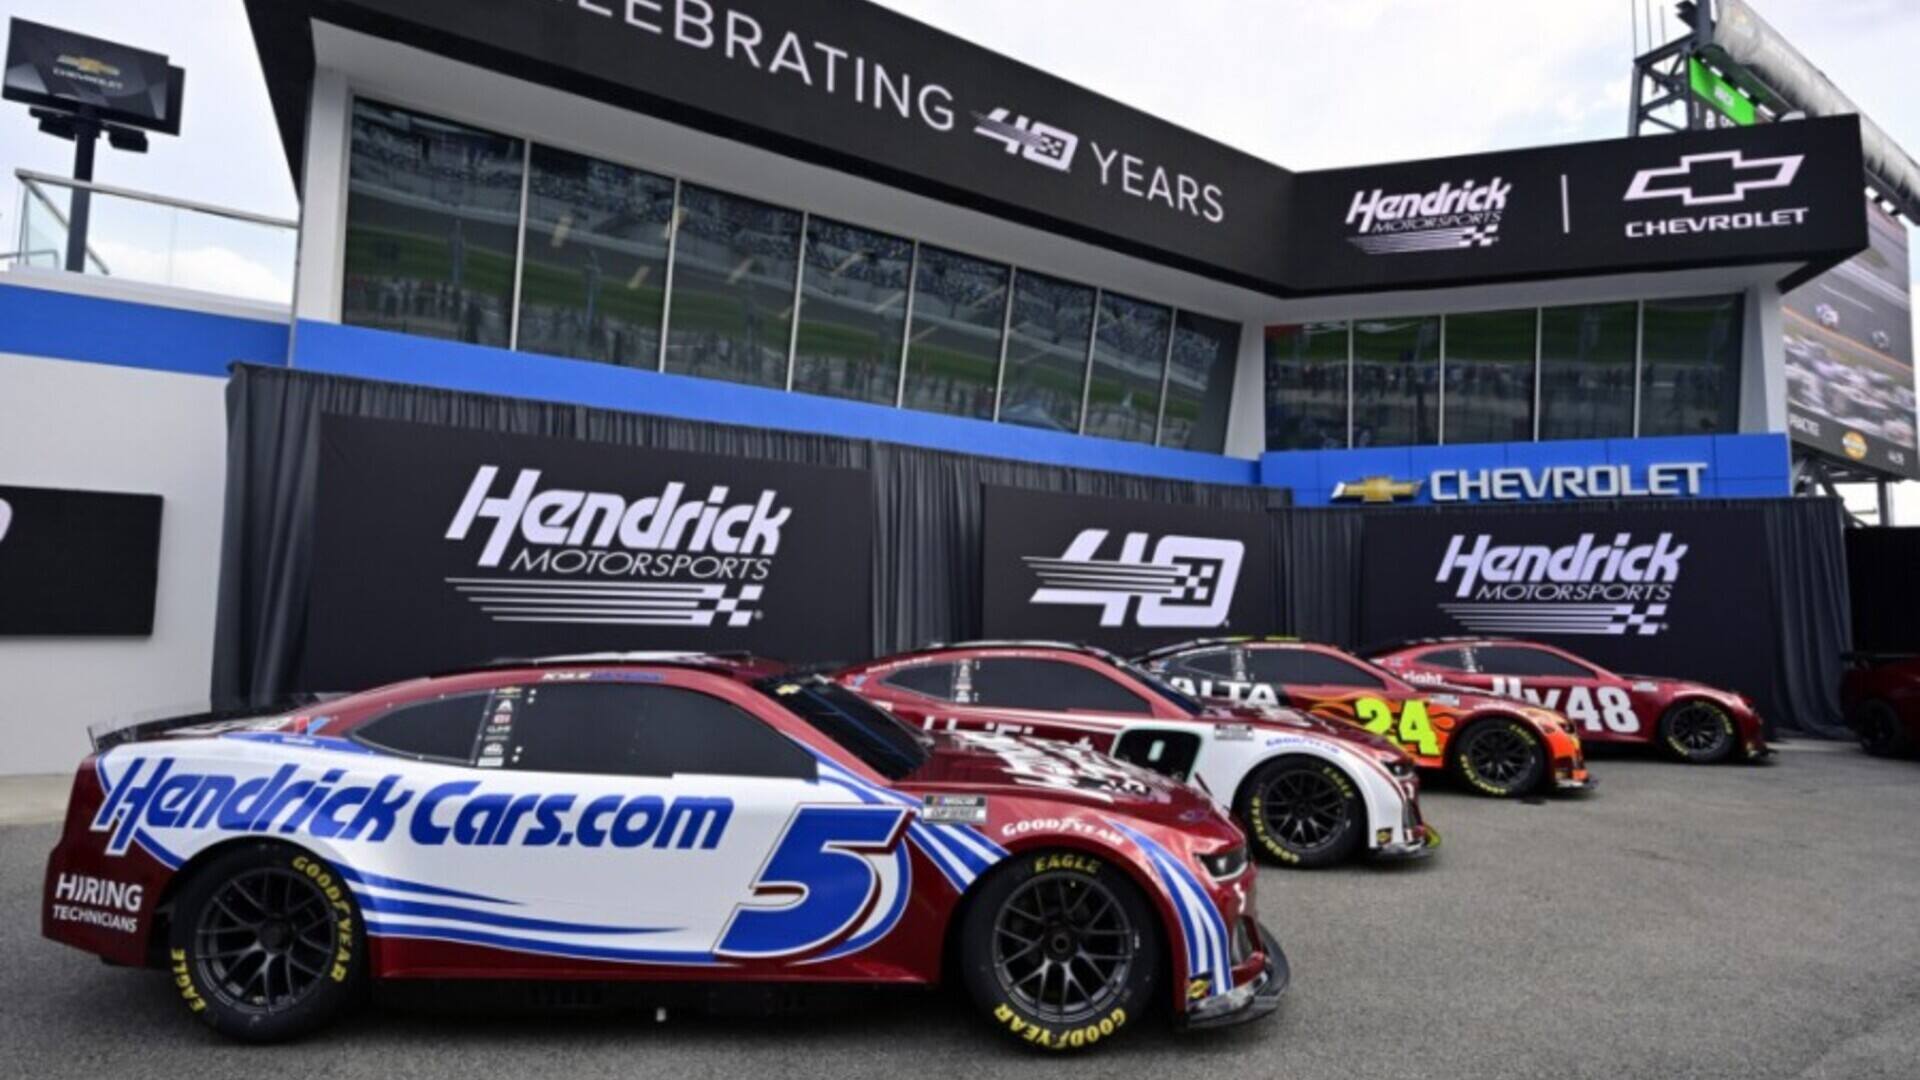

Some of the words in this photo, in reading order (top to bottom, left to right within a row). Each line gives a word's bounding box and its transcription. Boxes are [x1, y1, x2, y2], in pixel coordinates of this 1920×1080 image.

[974, 107, 1079, 172] 40
[1090, 140, 1224, 224] YEARS
[1345, 176, 1513, 234] Hendrick
[1372, 211, 1502, 233] MOTORSPORTS
[1624, 207, 1809, 238] CHEVROLET
[1430, 463, 1708, 501] CHEVROLET
[445, 465, 792, 567] Hendrick
[509, 547, 772, 581] MOTORSPORTS
[1029, 528, 1245, 627] 40
[1435, 532, 1689, 598] Hendrick
[1475, 582, 1673, 601] MOTORSPORTS
[1355, 697, 1440, 756] 24
[1566, 685, 1641, 734] 48
[1002, 817, 1124, 845] GOODYEAR
[712, 803, 908, 958] 5
[1035, 854, 1099, 873] EAGLE
[55, 872, 143, 912] HIRING
[53, 904, 138, 933] TECHNICIANS
[292, 856, 352, 982] GOODYEAR
[171, 949, 206, 1011] EAGLE
[994, 1003, 1126, 1049] GOODYEAR
